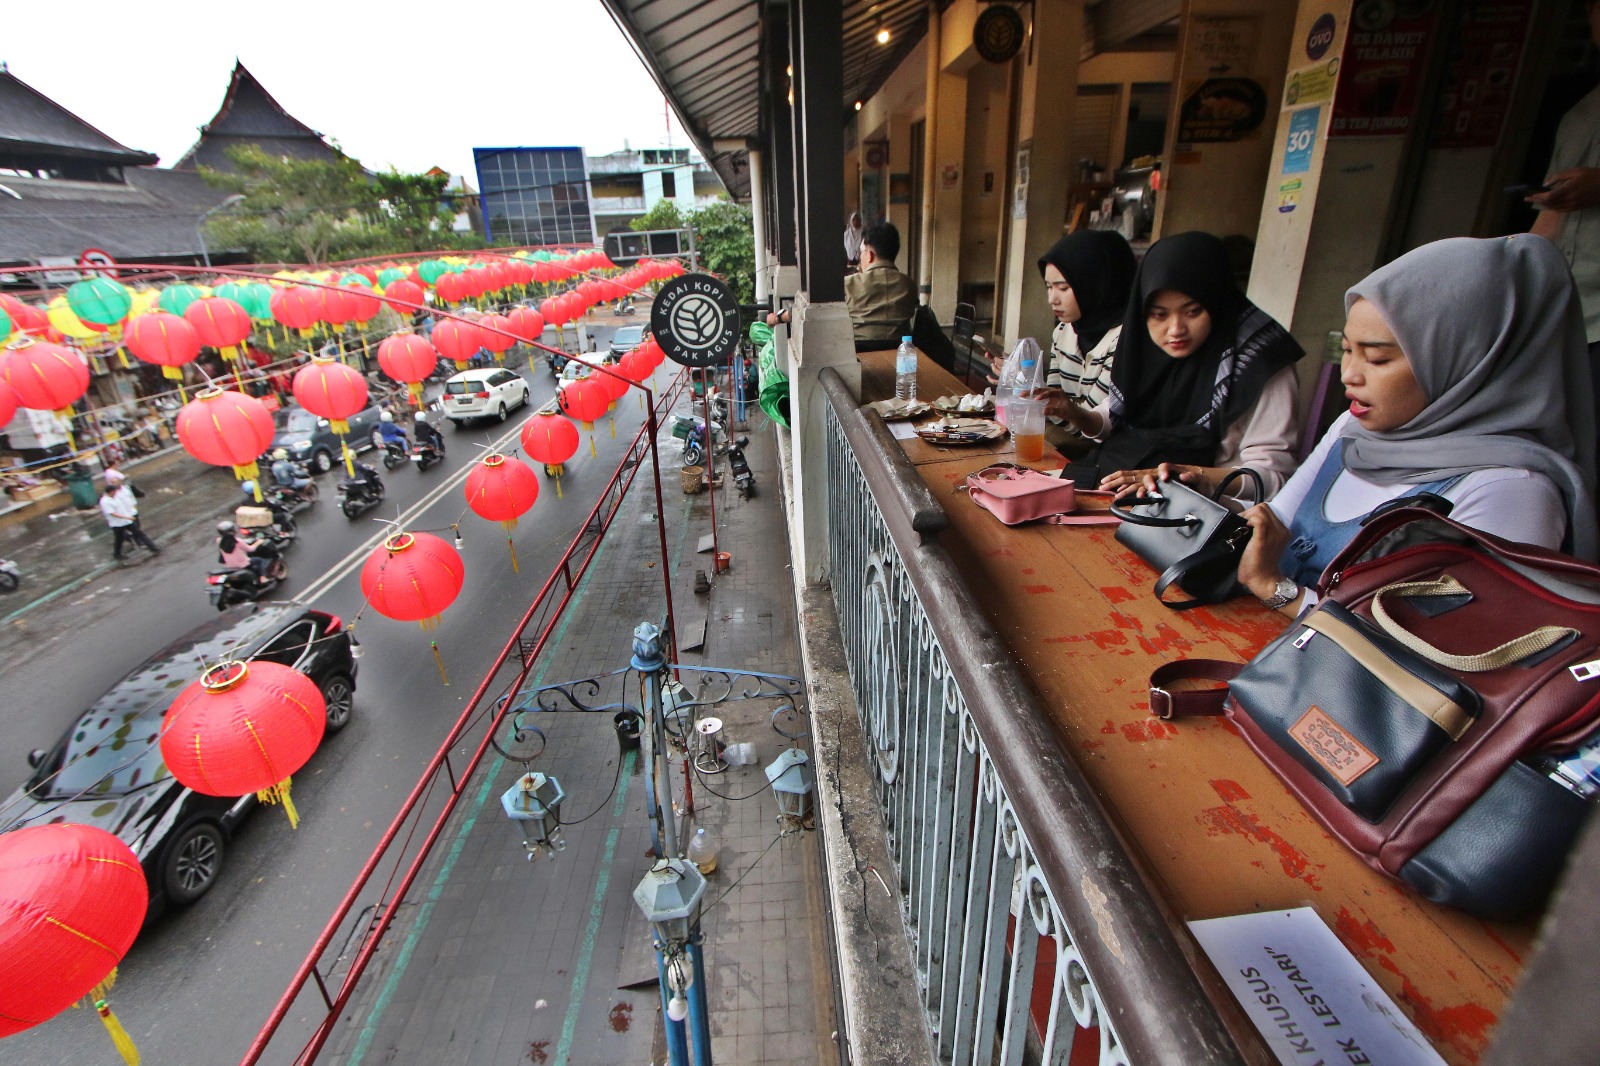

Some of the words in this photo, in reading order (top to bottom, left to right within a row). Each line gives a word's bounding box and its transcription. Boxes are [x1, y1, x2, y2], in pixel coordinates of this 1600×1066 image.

[1309, 31, 1332, 48] OVO
[1352, 32, 1371, 46] ES
[1372, 31, 1426, 45] DAWET
[1355, 46, 1416, 60] TELASIH
[1333, 117, 1348, 130] ES
[1348, 117, 1370, 129] TEH
[1370, 116, 1409, 131] JUMBO
[660, 283, 688, 315] KEDAI
[694, 281, 724, 300] KOPI
[659, 328, 670, 336] EST.
[673, 345, 698, 360] PAK
[707, 329, 733, 358] AGUS
[1308, 723, 1354, 765] QUEEN
[1240, 966, 1316, 1054] KHUSUS
[1336, 1037, 1375, 1066] EK
